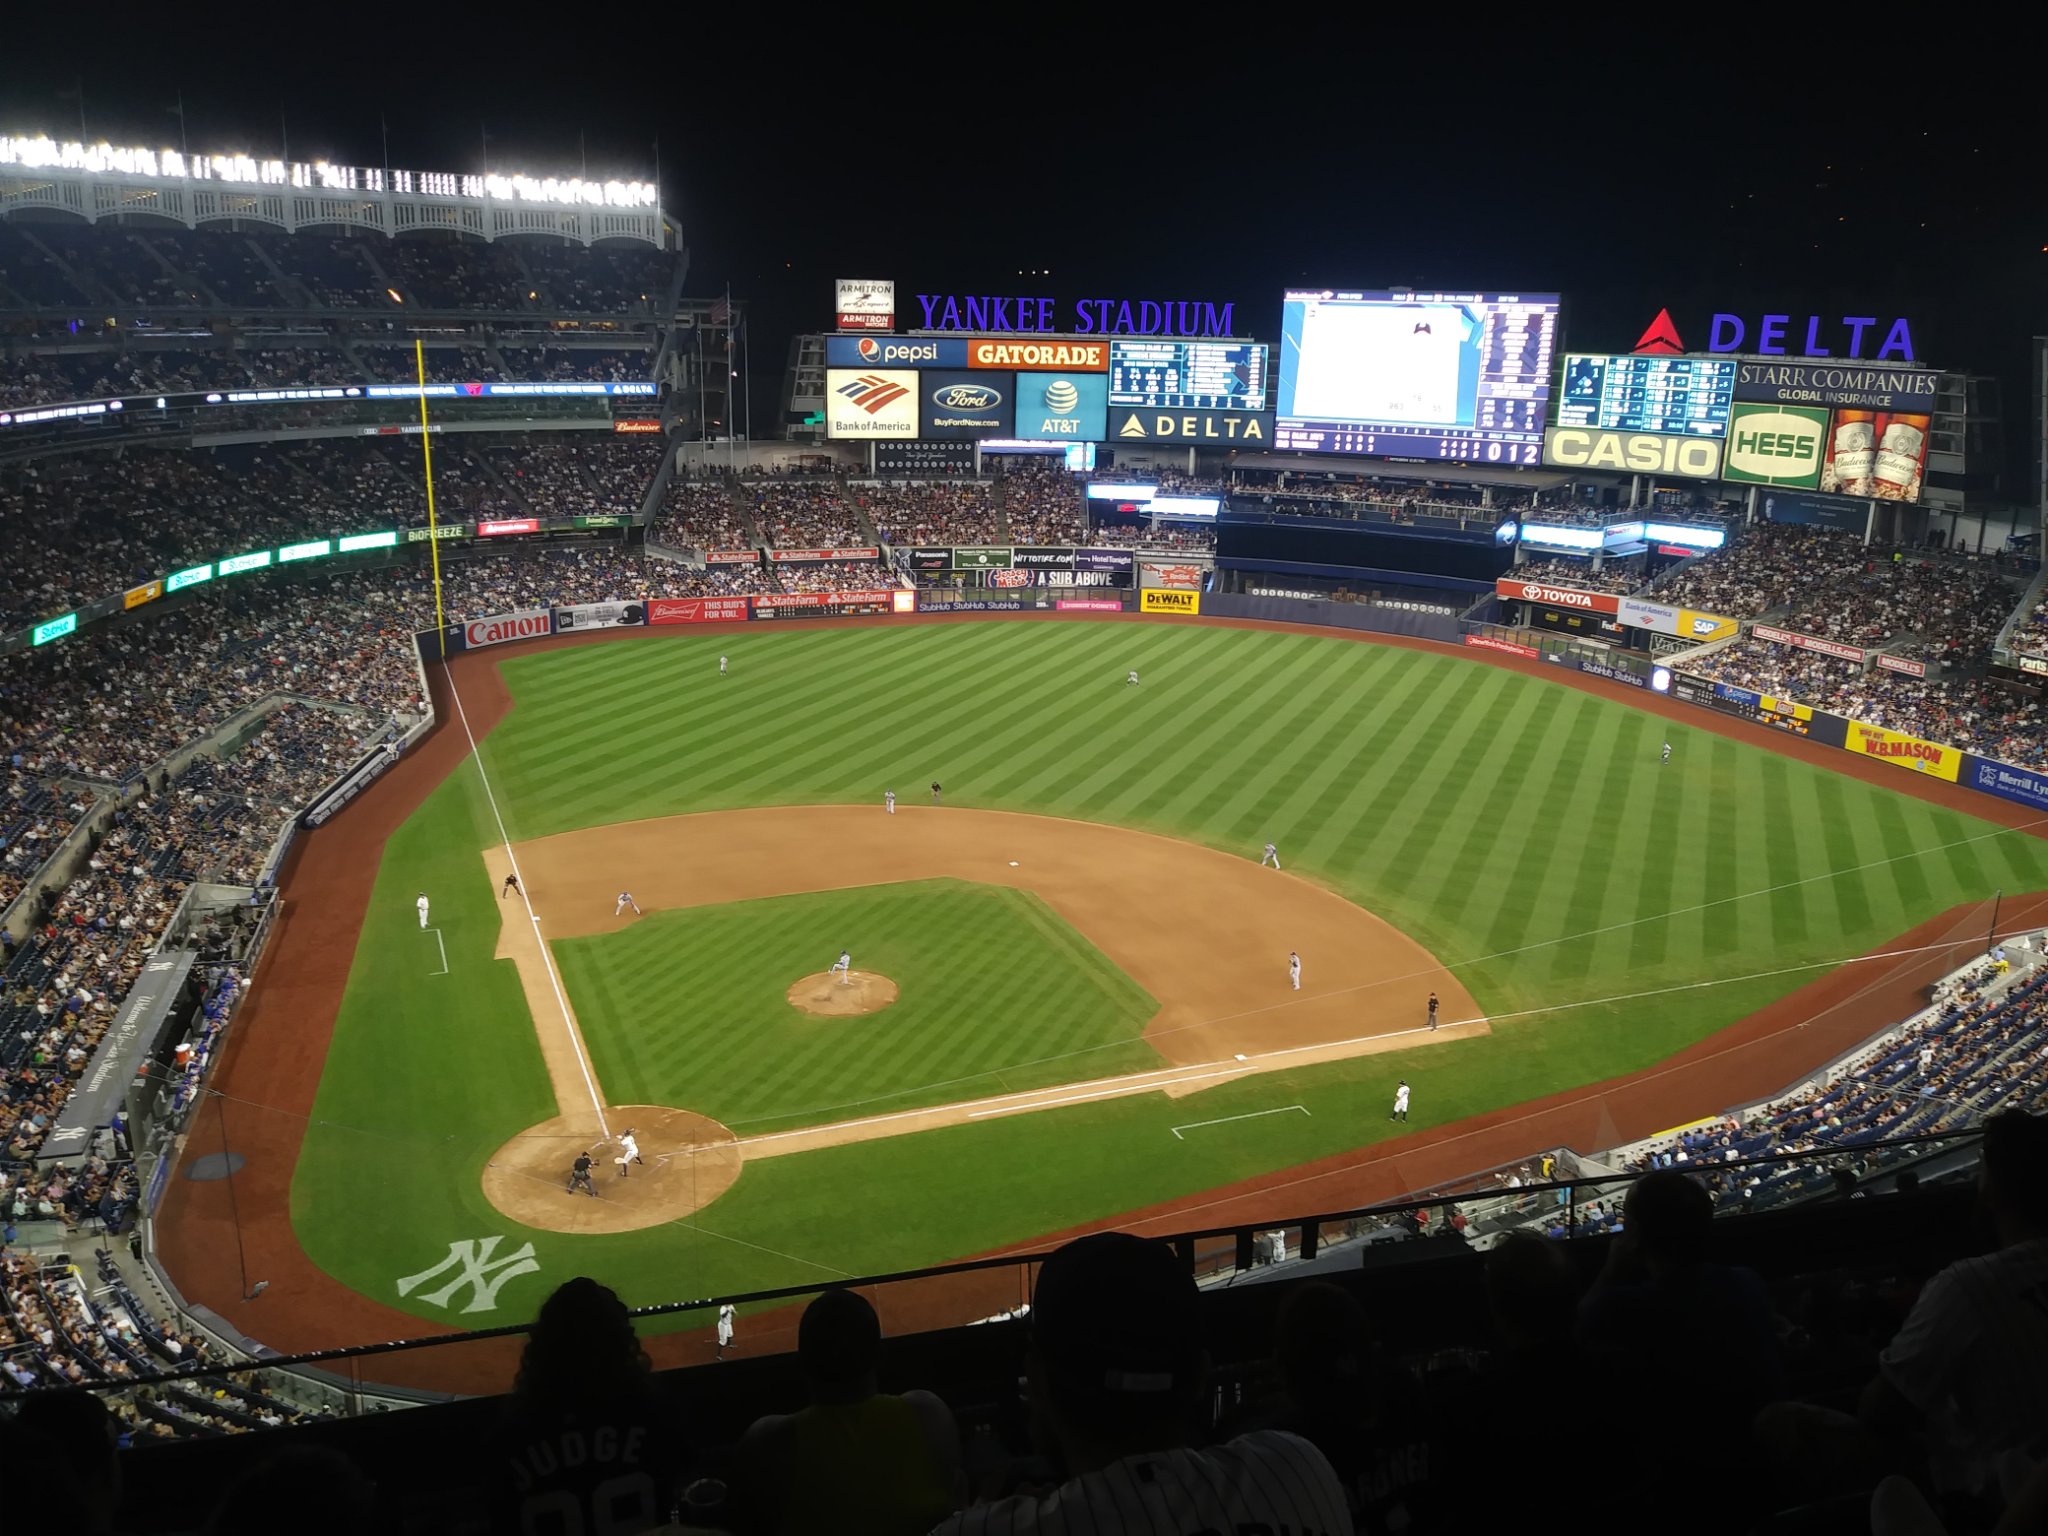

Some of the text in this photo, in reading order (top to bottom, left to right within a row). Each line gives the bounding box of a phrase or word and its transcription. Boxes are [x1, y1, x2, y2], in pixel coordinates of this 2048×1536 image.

[840, 284, 891, 293] ARMITRON
[842, 314, 889, 323] ARMITRON
[916, 294, 1234, 337] YANKEE STADIUM
[1709, 313, 1915, 361] DELTA
[884, 343, 938, 363] pepsi
[977, 344, 1101, 365] GATORADE
[1739, 364, 1937, 395] STARR COMPANIES
[946, 388, 988, 408] Ford
[1777, 388, 1892, 407] GLOBAL INSURANCE
[614, 421, 660, 432] Budweiser
[836, 421, 911, 431] Bank of America
[934, 418, 1000, 428] BuyFordNow.com
[1041, 419, 1081, 434] AT&T
[1156, 415, 1263, 440] DELTA
[1334, 442, 1341, 450] 2
[1488, 442, 1538, 464] 0 1 2
[1552, 430, 1718, 476] CASIO
[1736, 431, 1815, 460] HESS
[1014, 553, 1073, 564] NITTOTIRE.COM
[1037, 571, 1113, 586] A SUB ABOVE
[704, 599, 746, 611] THIS BUD'S
[1542, 589, 1592, 607] TOYOTA
[657, 605, 694, 616] Budweiser
[704, 609, 739, 619] FOR YOU.
[919, 601, 1020, 612] StubHub StubHub StubHub
[1625, 602, 1672, 618] Bank of America
[467, 615, 549, 645] Canon
[1601, 620, 1625, 633] FedEx
[1694, 621, 1714, 634] SAP
[1804, 639, 1861, 659] MODELLS.com
[2019, 657, 2047, 672] Parts
[1582, 663, 1643, 687] StubHub StubHub
[1733, 690, 1752, 701] pepsi
[1998, 771, 2033, 790] Merrill
[509, 1424, 647, 1492] JUDGE
